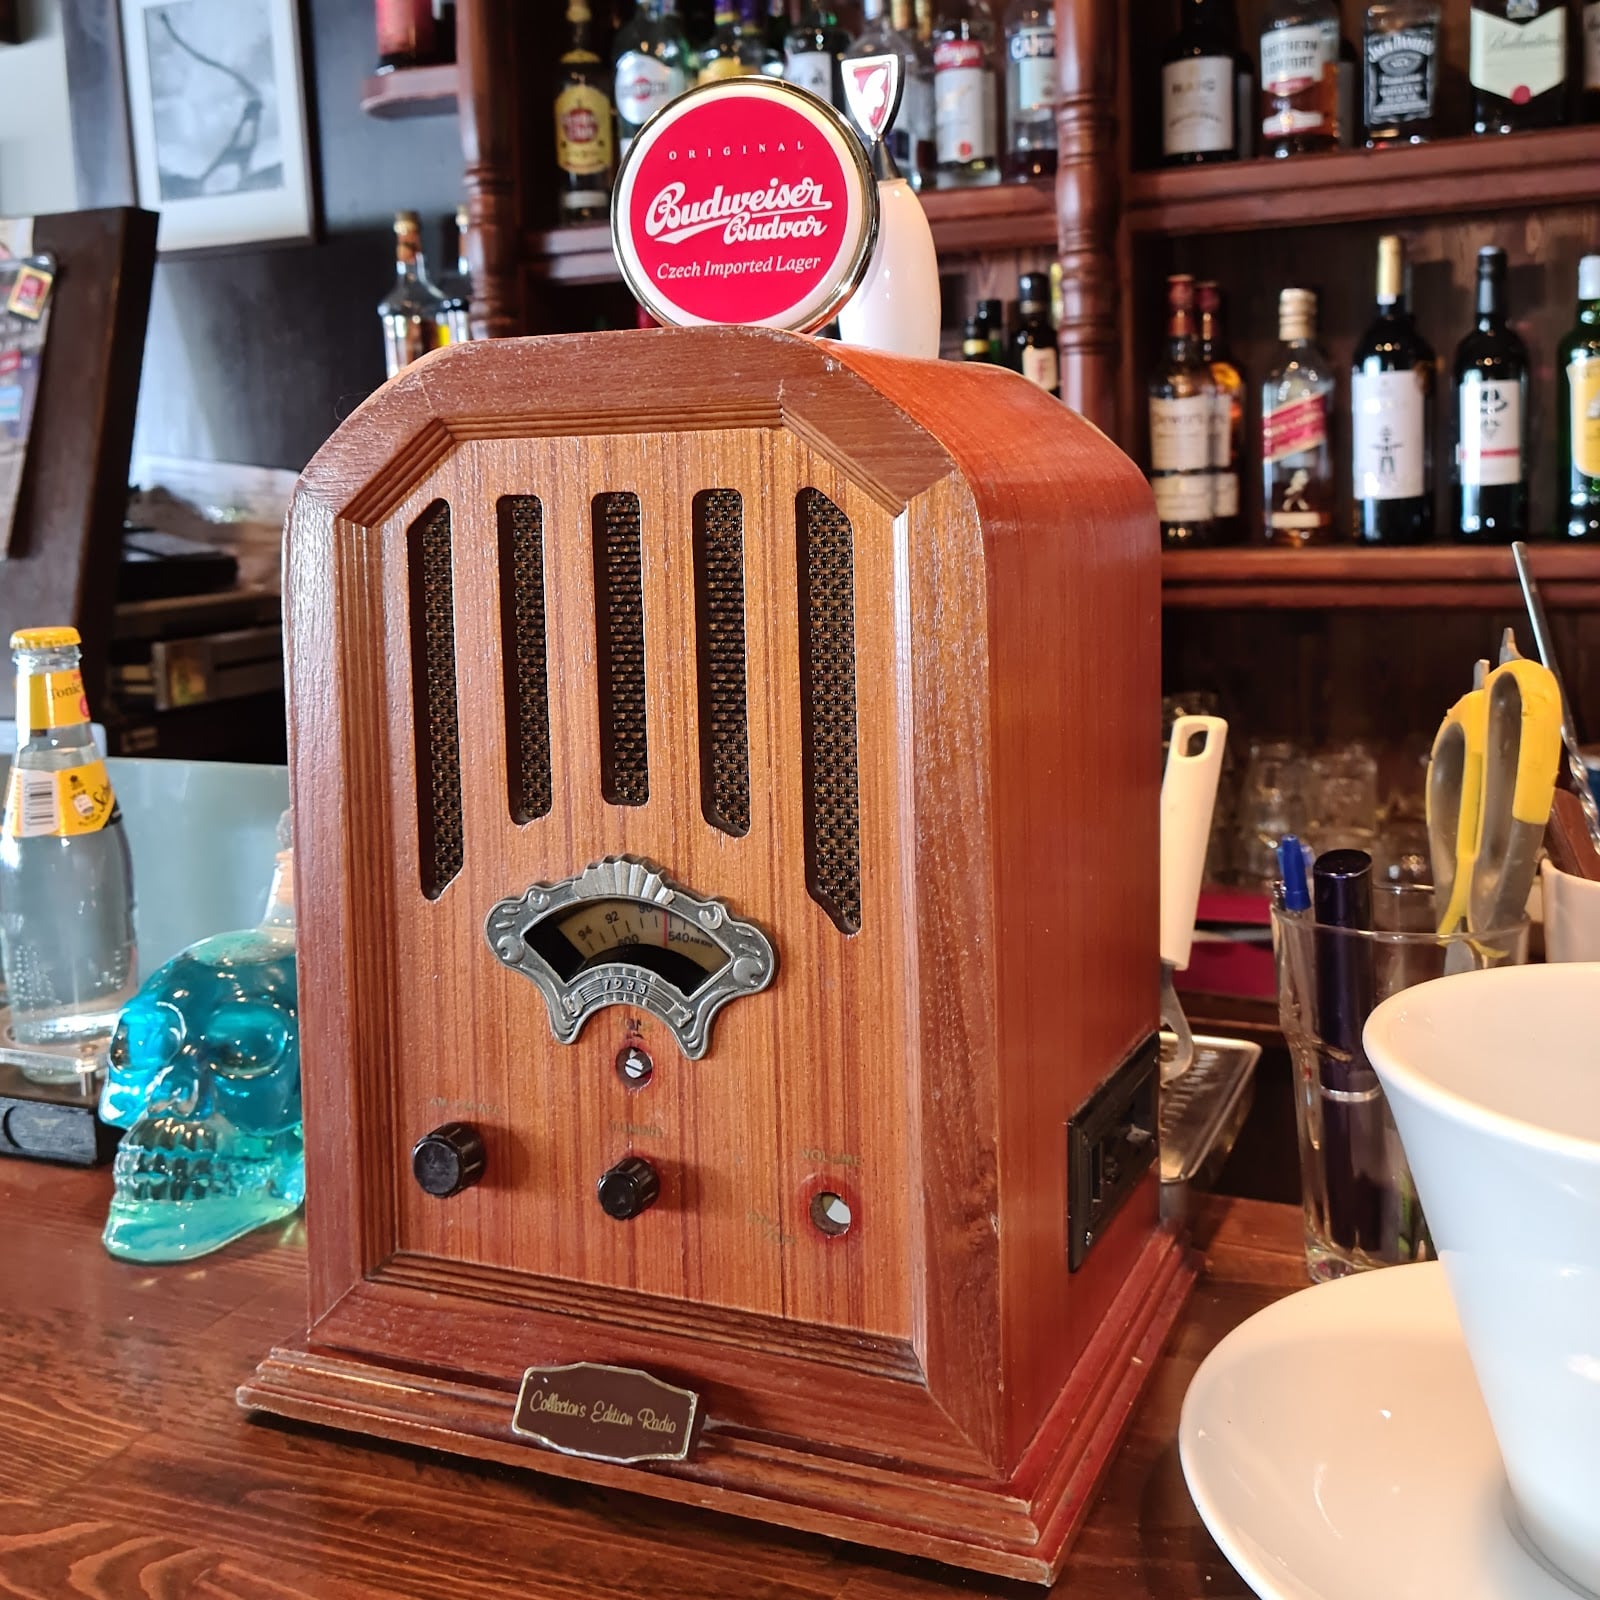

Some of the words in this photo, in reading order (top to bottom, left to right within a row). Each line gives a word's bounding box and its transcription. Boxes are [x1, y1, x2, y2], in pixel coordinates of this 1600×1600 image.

[668, 141, 804, 161] ORIGINAL
[645, 177, 832, 245] Budweiser
[723, 211, 828, 246] Budvar
[656, 258, 701, 280] Czech
[704, 257, 773, 280] Imported
[776, 254, 821, 274] Lager
[578, 925, 592, 941] 94
[605, 911, 620, 925] 92
[668, 930, 690, 943] 540
[604, 977, 648, 995] 1933
[590, 1400, 633, 1426] Edition
[637, 1407, 677, 1434] Radio
